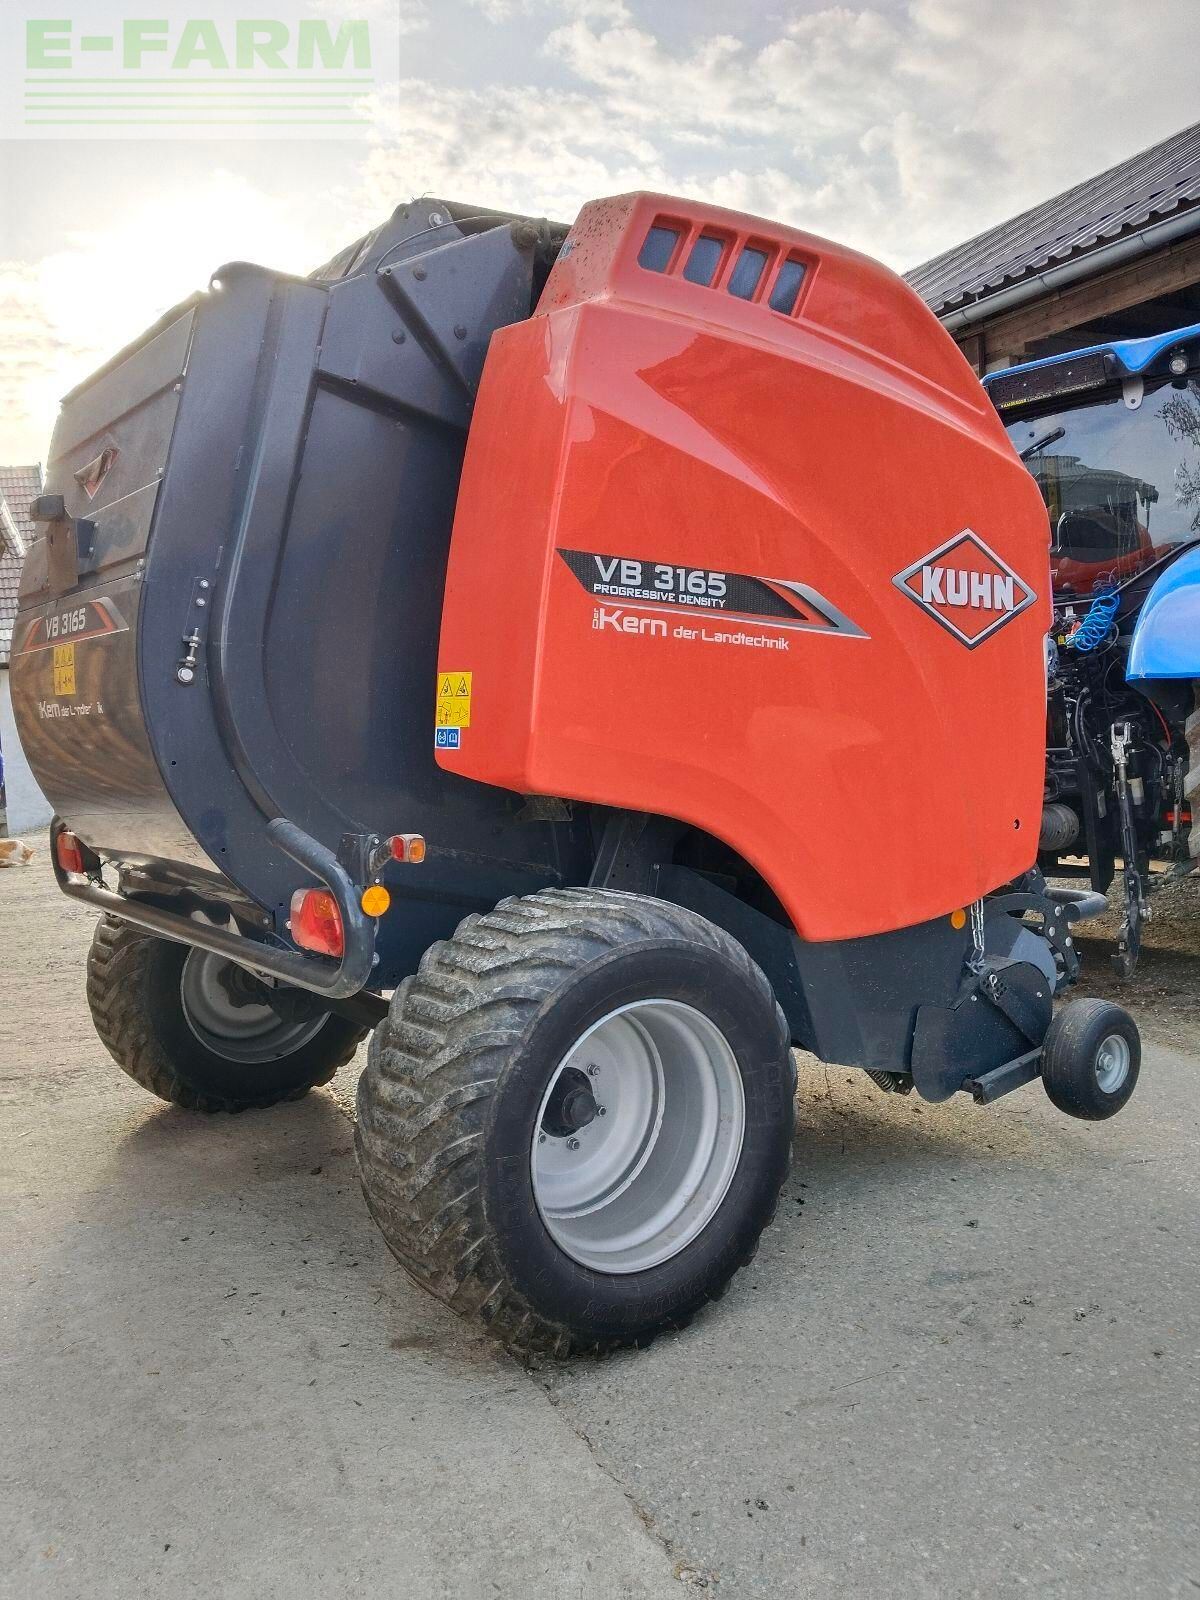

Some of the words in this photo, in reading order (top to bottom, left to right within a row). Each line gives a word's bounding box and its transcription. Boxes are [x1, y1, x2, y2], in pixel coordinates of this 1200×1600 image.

[593, 555, 643, 585] VB
[654, 564, 727, 597] 3165
[593, 583, 676, 603] PROGRESSIVE
[678, 595, 726, 608] DENSITY
[922, 565, 1014, 611] KUHN
[45, 616, 59, 638] VB
[61, 608, 86, 634] 3165
[599, 607, 667, 637] Kern
[673, 625, 699, 640] der
[701, 628, 790, 651] Landtechnik
